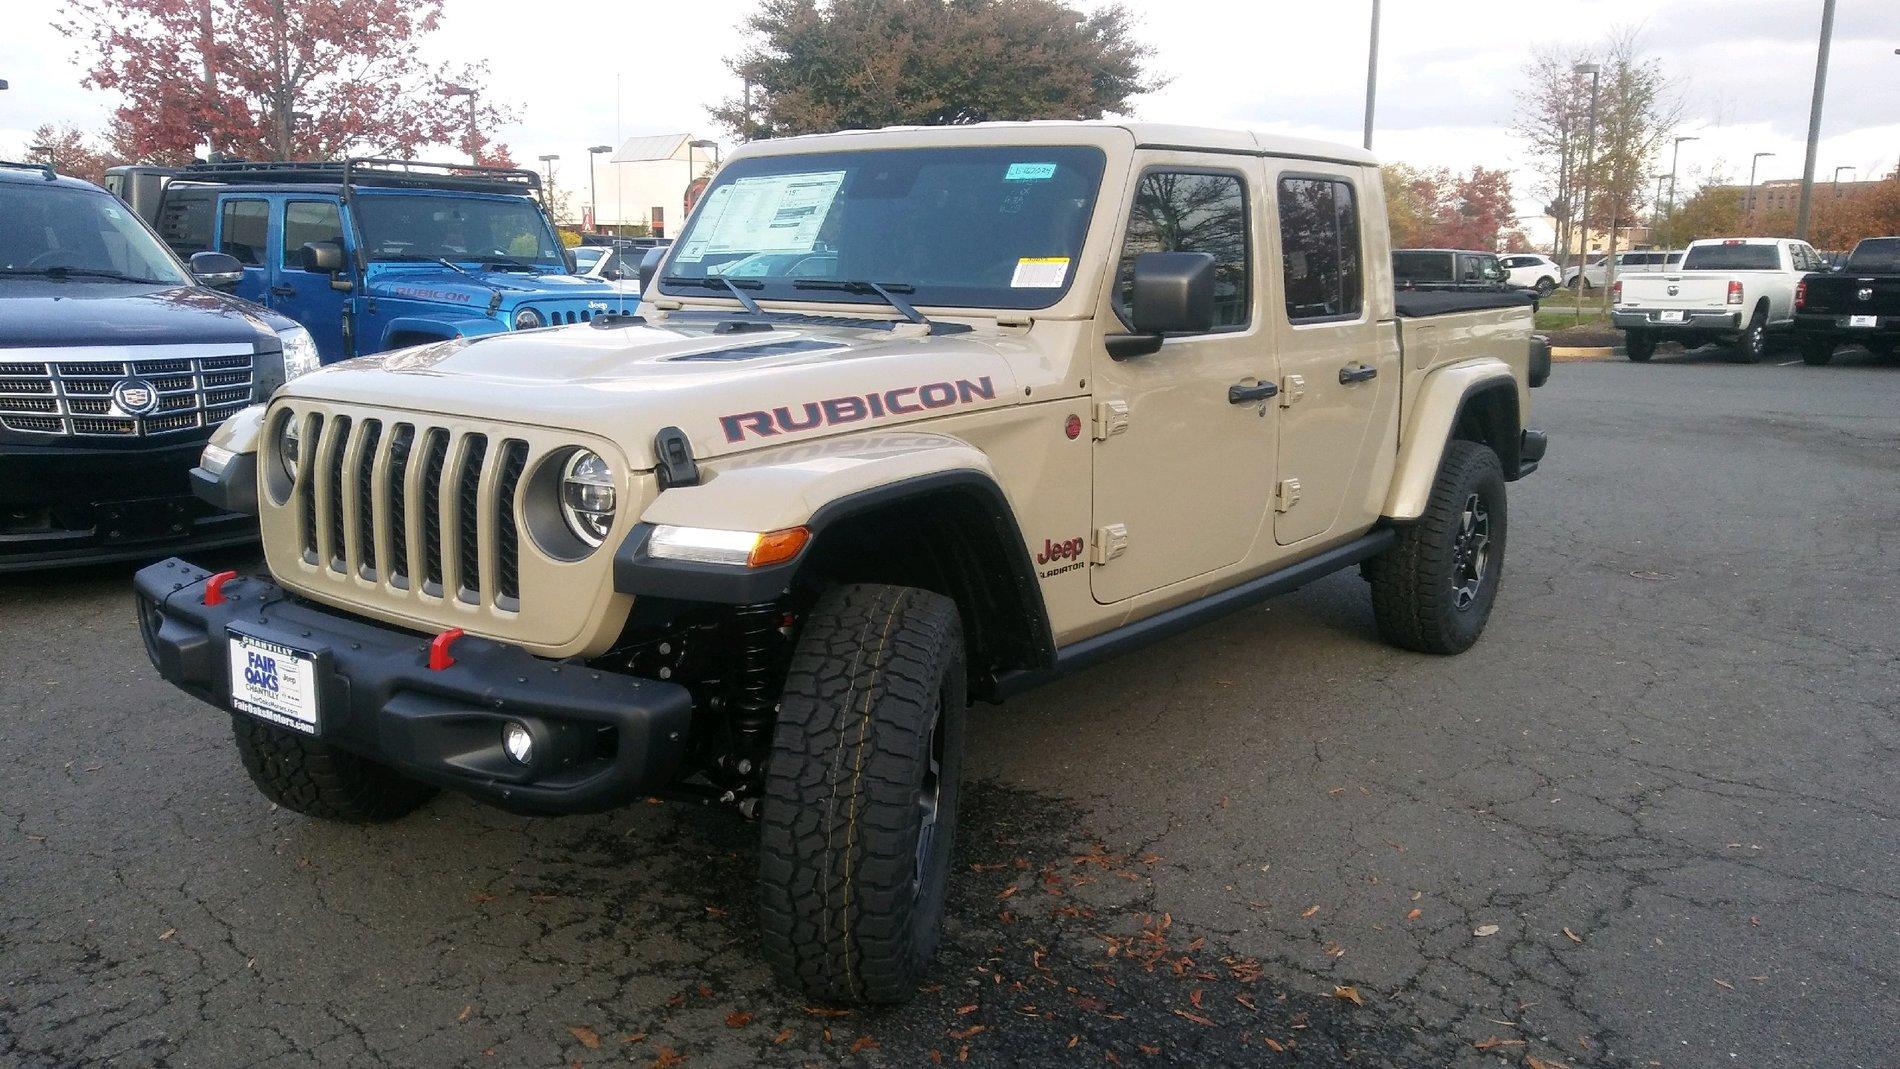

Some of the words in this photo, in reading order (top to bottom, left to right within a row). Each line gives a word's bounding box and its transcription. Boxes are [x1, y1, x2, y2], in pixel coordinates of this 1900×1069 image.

[396, 287, 471, 302] RUBICON
[588, 301, 608, 310] Jeep
[718, 375, 997, 444] RUBICON
[1036, 537, 1084, 565] Jeep
[247, 651, 277, 676] FAIR
[244, 666, 279, 693] OAKS
[245, 683, 280, 701] CHANTILLY
[233, 698, 315, 734] FairOaksMotors.com
